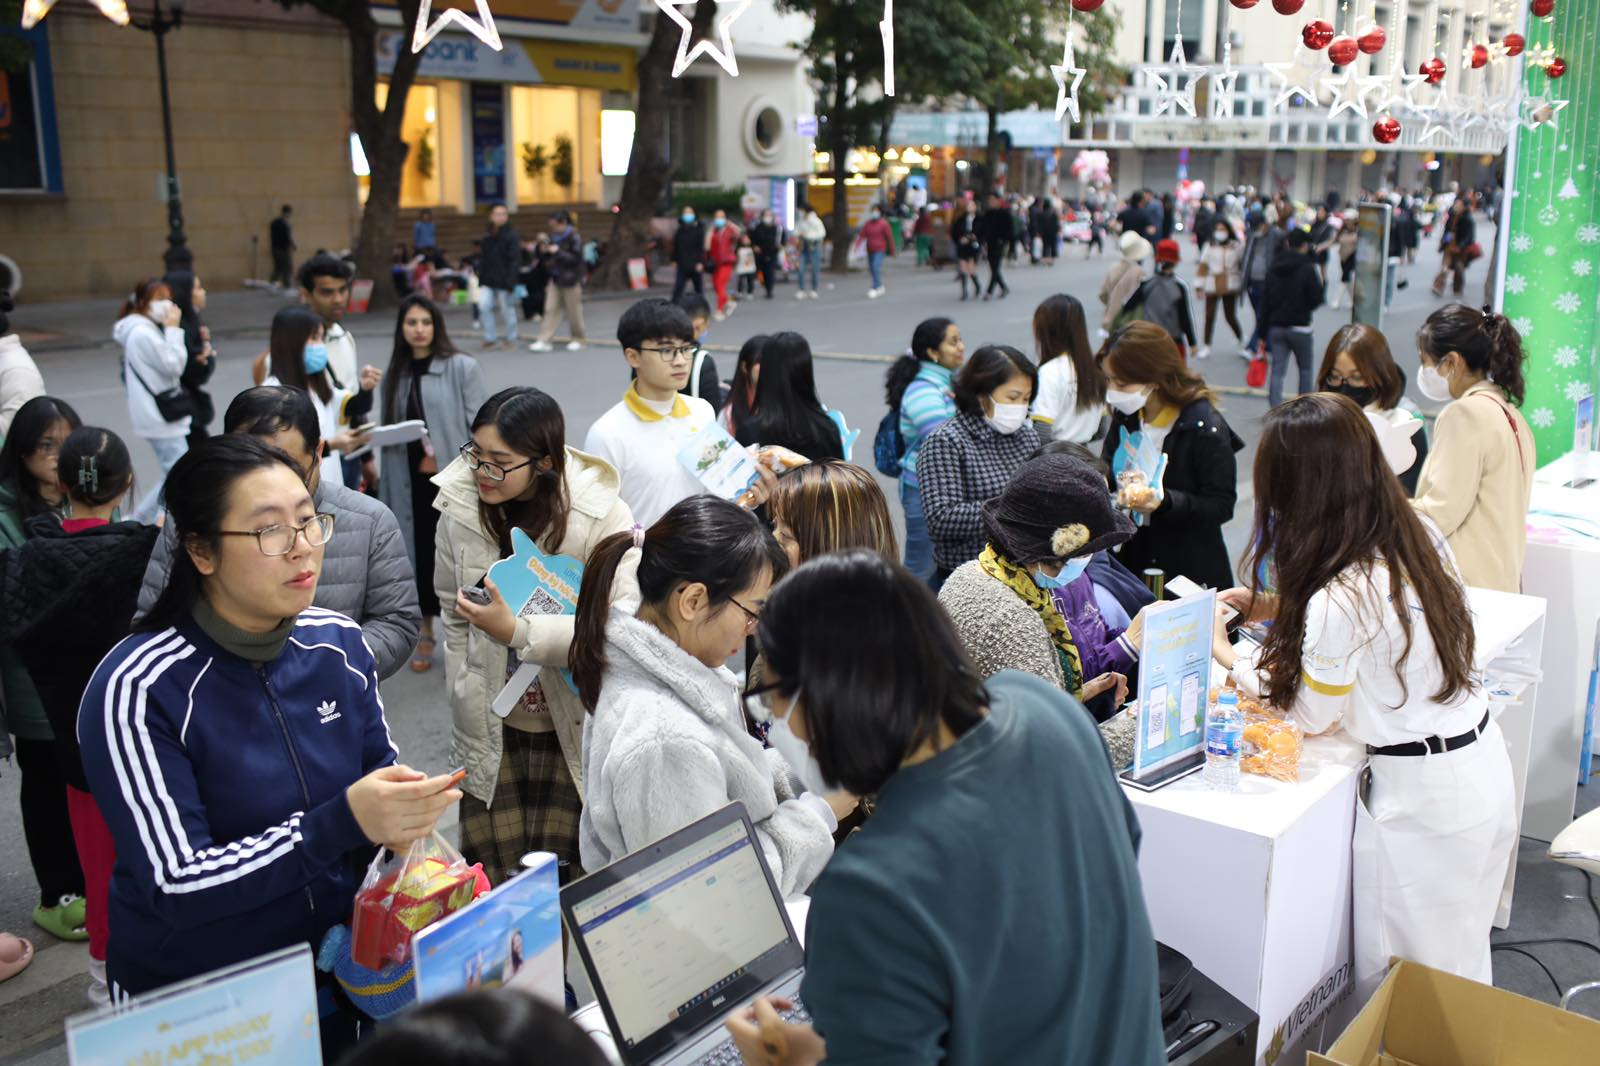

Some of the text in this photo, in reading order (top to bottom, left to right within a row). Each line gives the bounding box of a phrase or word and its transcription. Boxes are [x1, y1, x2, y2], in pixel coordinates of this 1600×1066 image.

[320, 712, 342, 724] adidas
[712, 995, 726, 1008] DELL
[1287, 962, 1348, 1039] Vietnam
